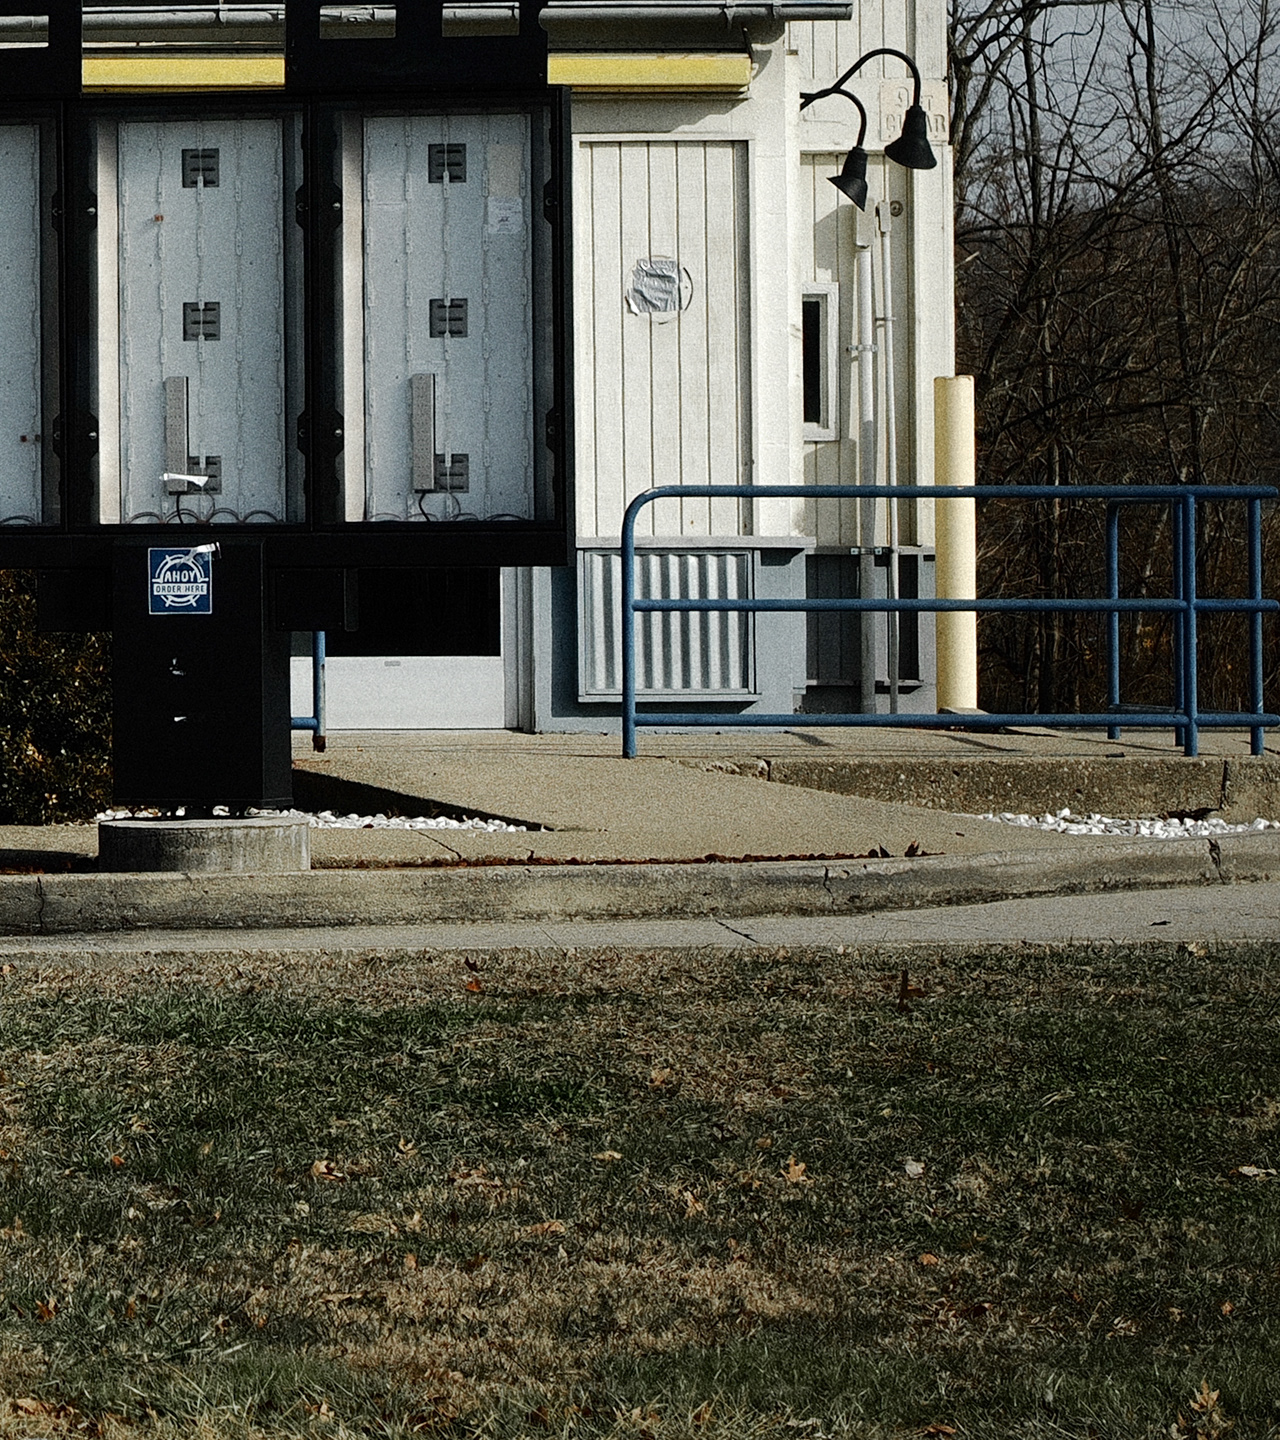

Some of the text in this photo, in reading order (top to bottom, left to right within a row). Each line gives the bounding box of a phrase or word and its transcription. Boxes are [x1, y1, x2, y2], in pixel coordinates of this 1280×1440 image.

[164, 570, 196, 582] AHOY
[155, 584, 205, 593] ORDER HERE
